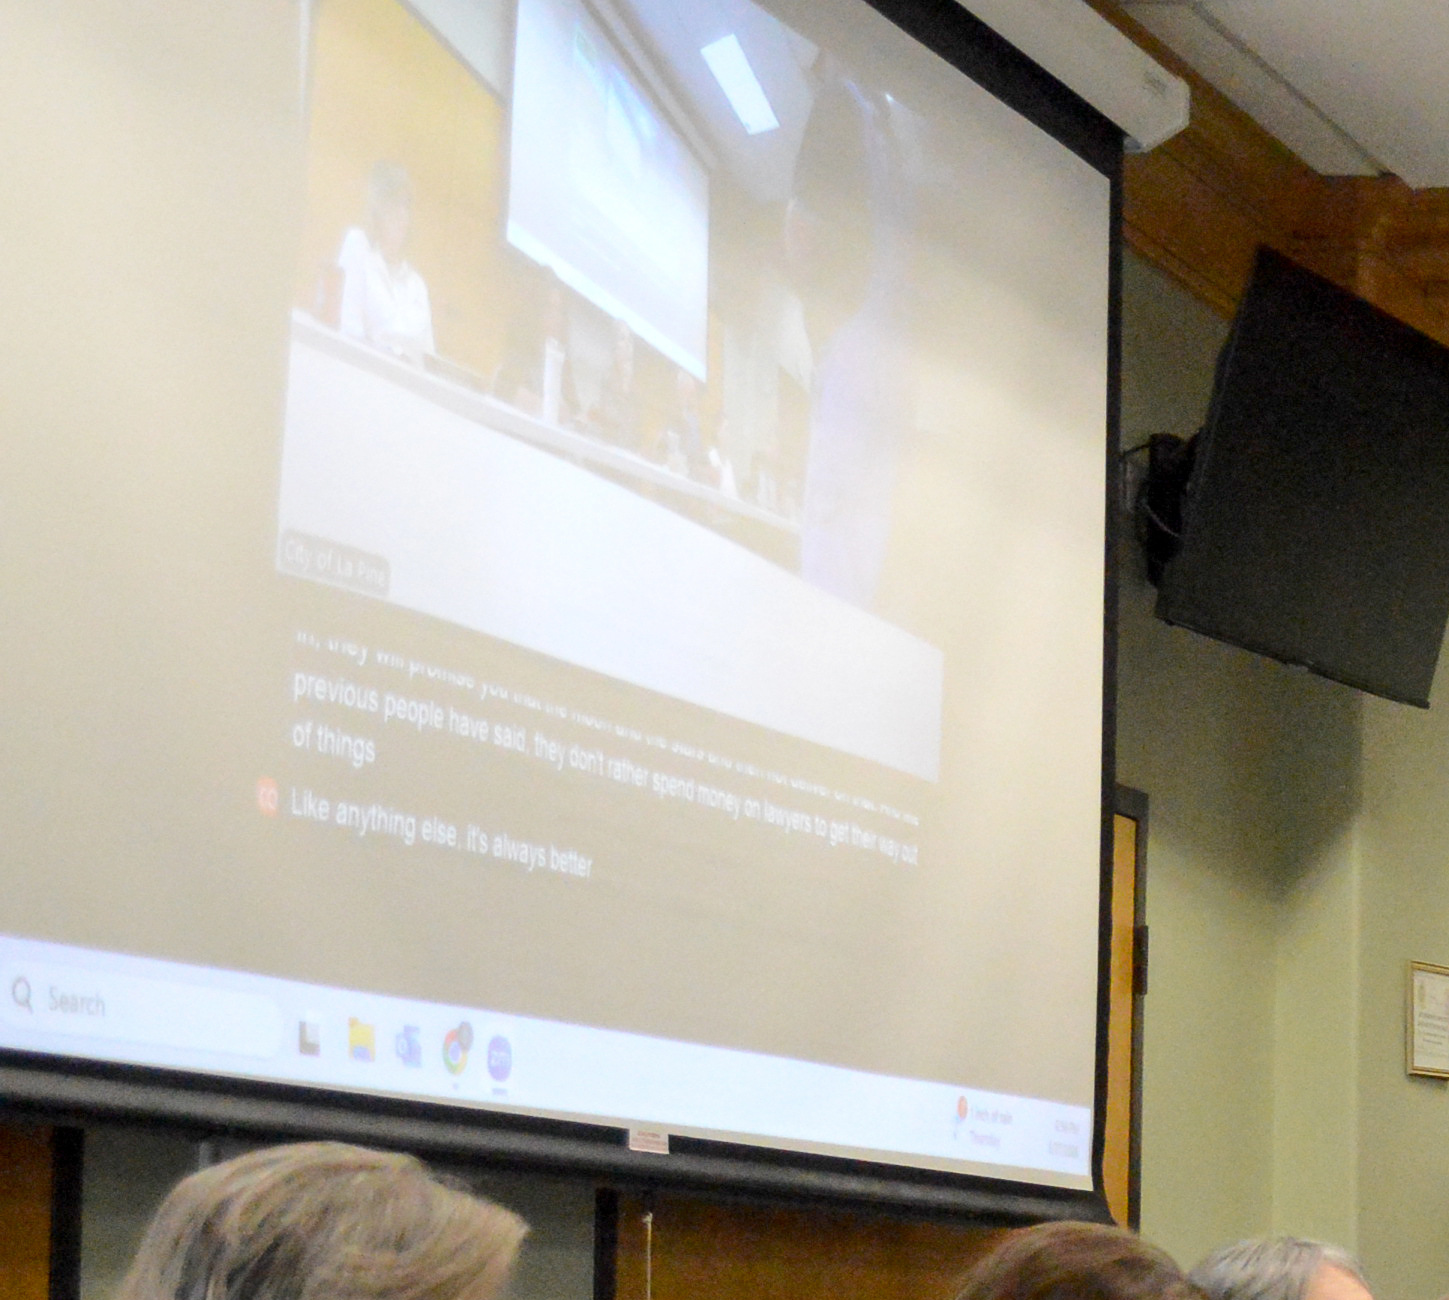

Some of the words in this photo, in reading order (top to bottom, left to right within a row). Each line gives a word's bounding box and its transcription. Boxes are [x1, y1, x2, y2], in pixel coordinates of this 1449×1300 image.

[293, 721, 312, 748] of
[317, 724, 375, 768] things
[294, 672, 378, 713] previous
[384, 693, 443, 731] people
[449, 707, 489, 741] have
[534, 731, 565, 770] they
[570, 745, 604, 776] don't
[608, 757, 649, 787] rather
[652, 771, 694, 800] spend
[698, 784, 740, 820] money
[744, 799, 761, 818] on
[764, 800, 811, 834] lawyers
[815, 816, 827, 838] to
[830, 821, 849, 846] get
[291, 787, 330, 821] Like
[336, 801, 416, 846] anything
[467, 824, 489, 854] it's
[493, 834, 546, 872] always
[549, 845, 593, 878] better
[49, 984, 106, 1017] Search
